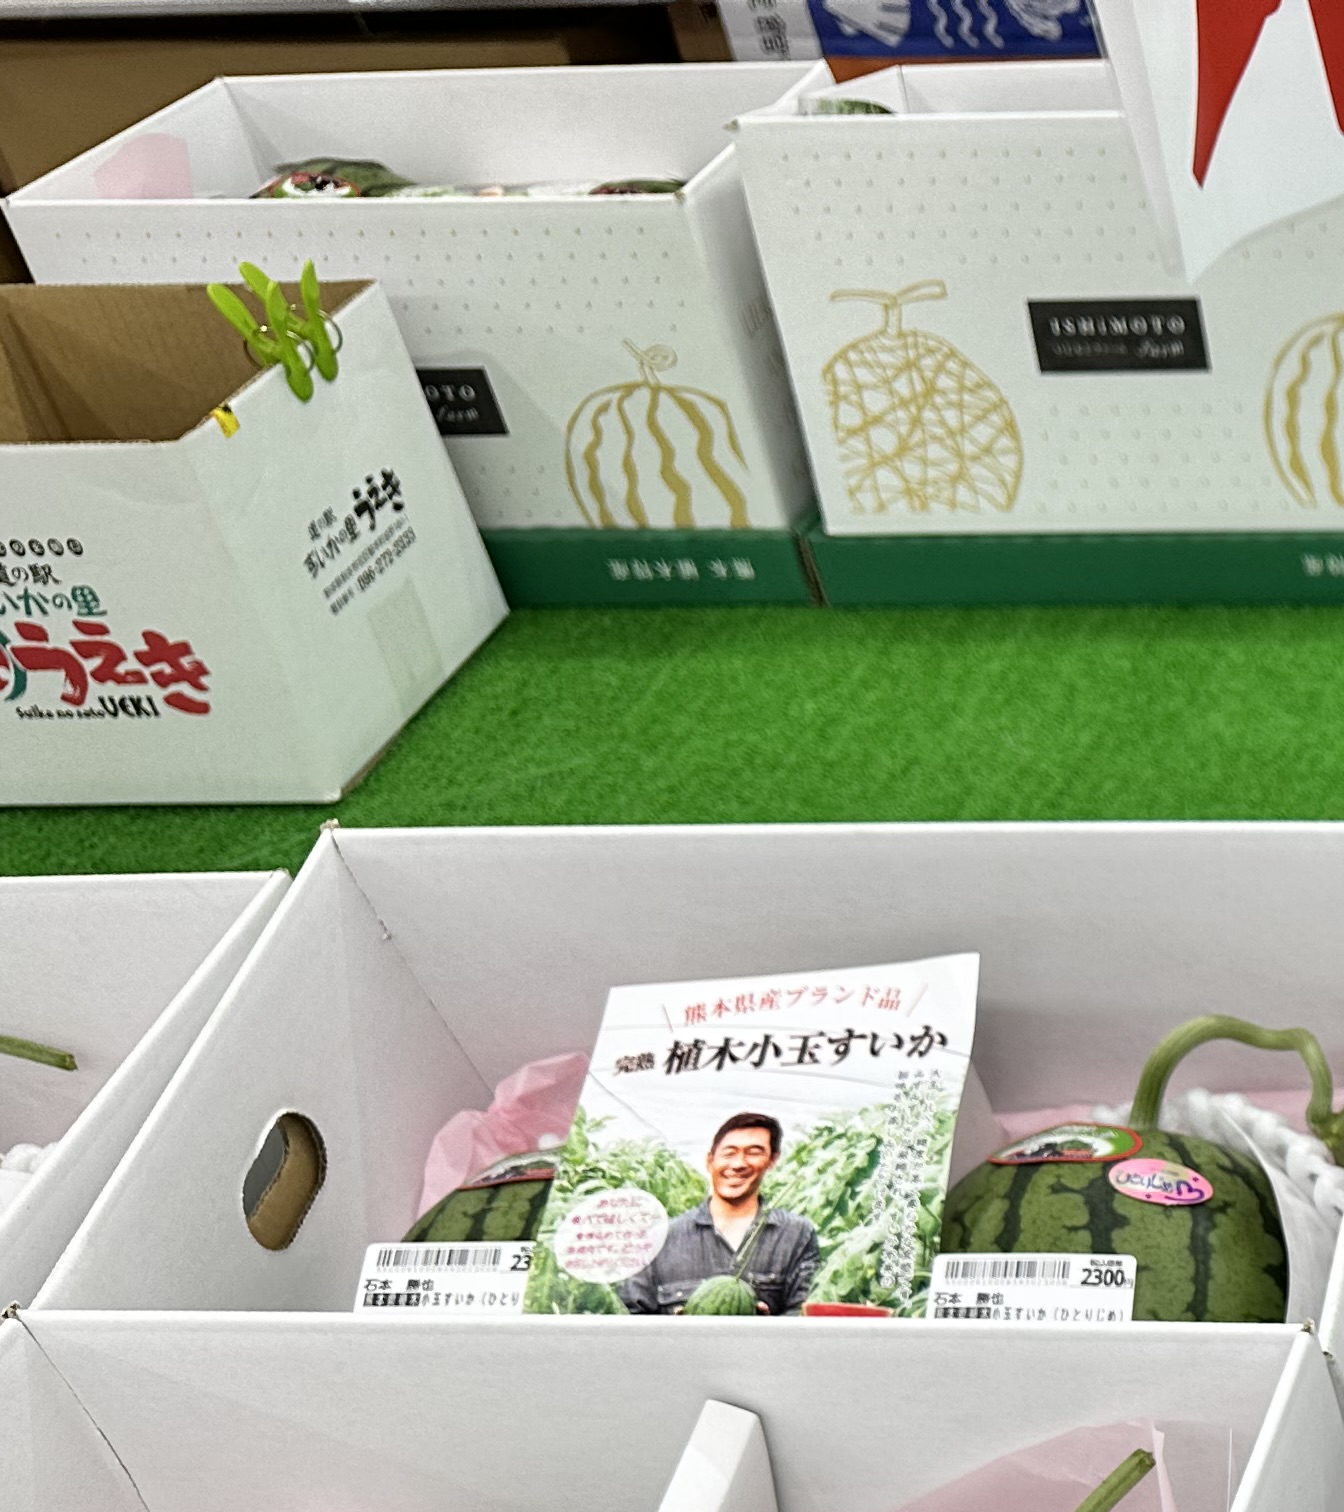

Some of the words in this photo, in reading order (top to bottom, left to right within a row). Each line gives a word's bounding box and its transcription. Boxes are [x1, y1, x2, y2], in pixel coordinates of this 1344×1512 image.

[683, 984, 902, 1026] 熊本県産ブランド品
[663, 1024, 949, 1076] 植木小玉すいか
